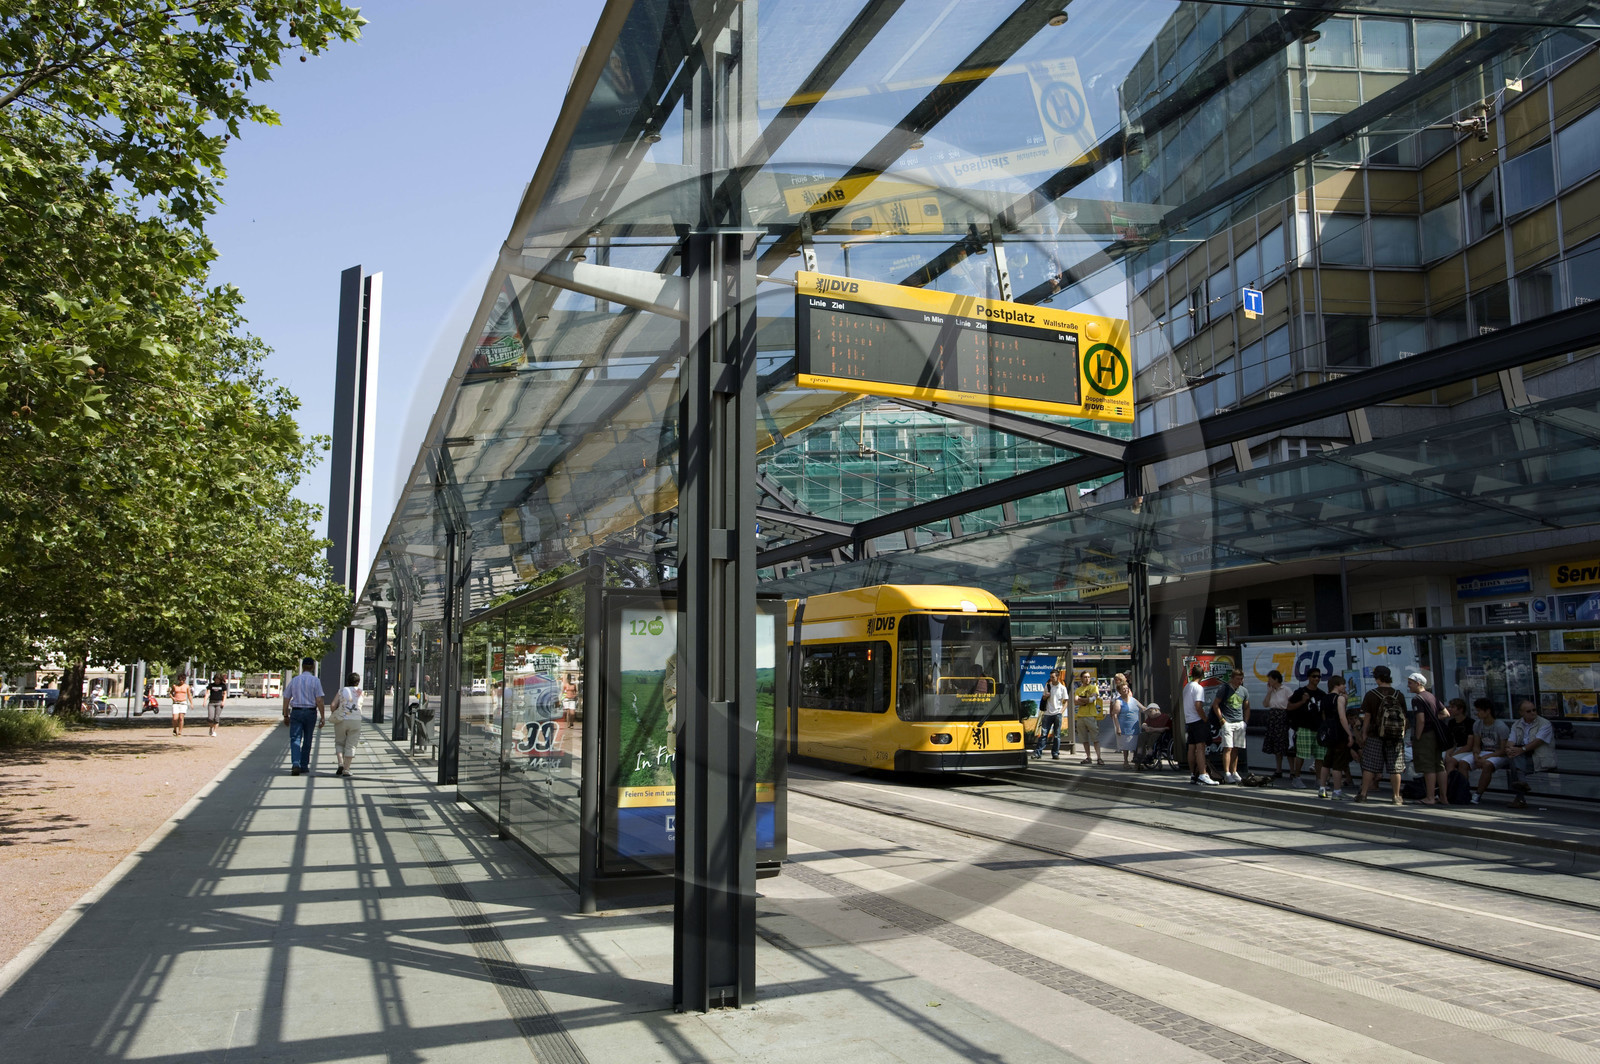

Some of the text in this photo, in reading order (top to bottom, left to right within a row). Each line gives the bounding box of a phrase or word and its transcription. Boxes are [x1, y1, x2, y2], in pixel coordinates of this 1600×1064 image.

[830, 280, 859, 293] DVB
[809, 298, 845, 310] Linie Ziel
[976, 304, 1079, 331] Postplatz Wallstraße
[1091, 403, 1105, 411] DVB
[876, 616, 896, 631] DVB
[1387, 646, 1402, 656] GLS
[1294, 649, 1336, 682] GLS
[634, 750, 652, 771] In
[624, 790, 643, 798] Feiern
[655, 789, 665, 797] mit
